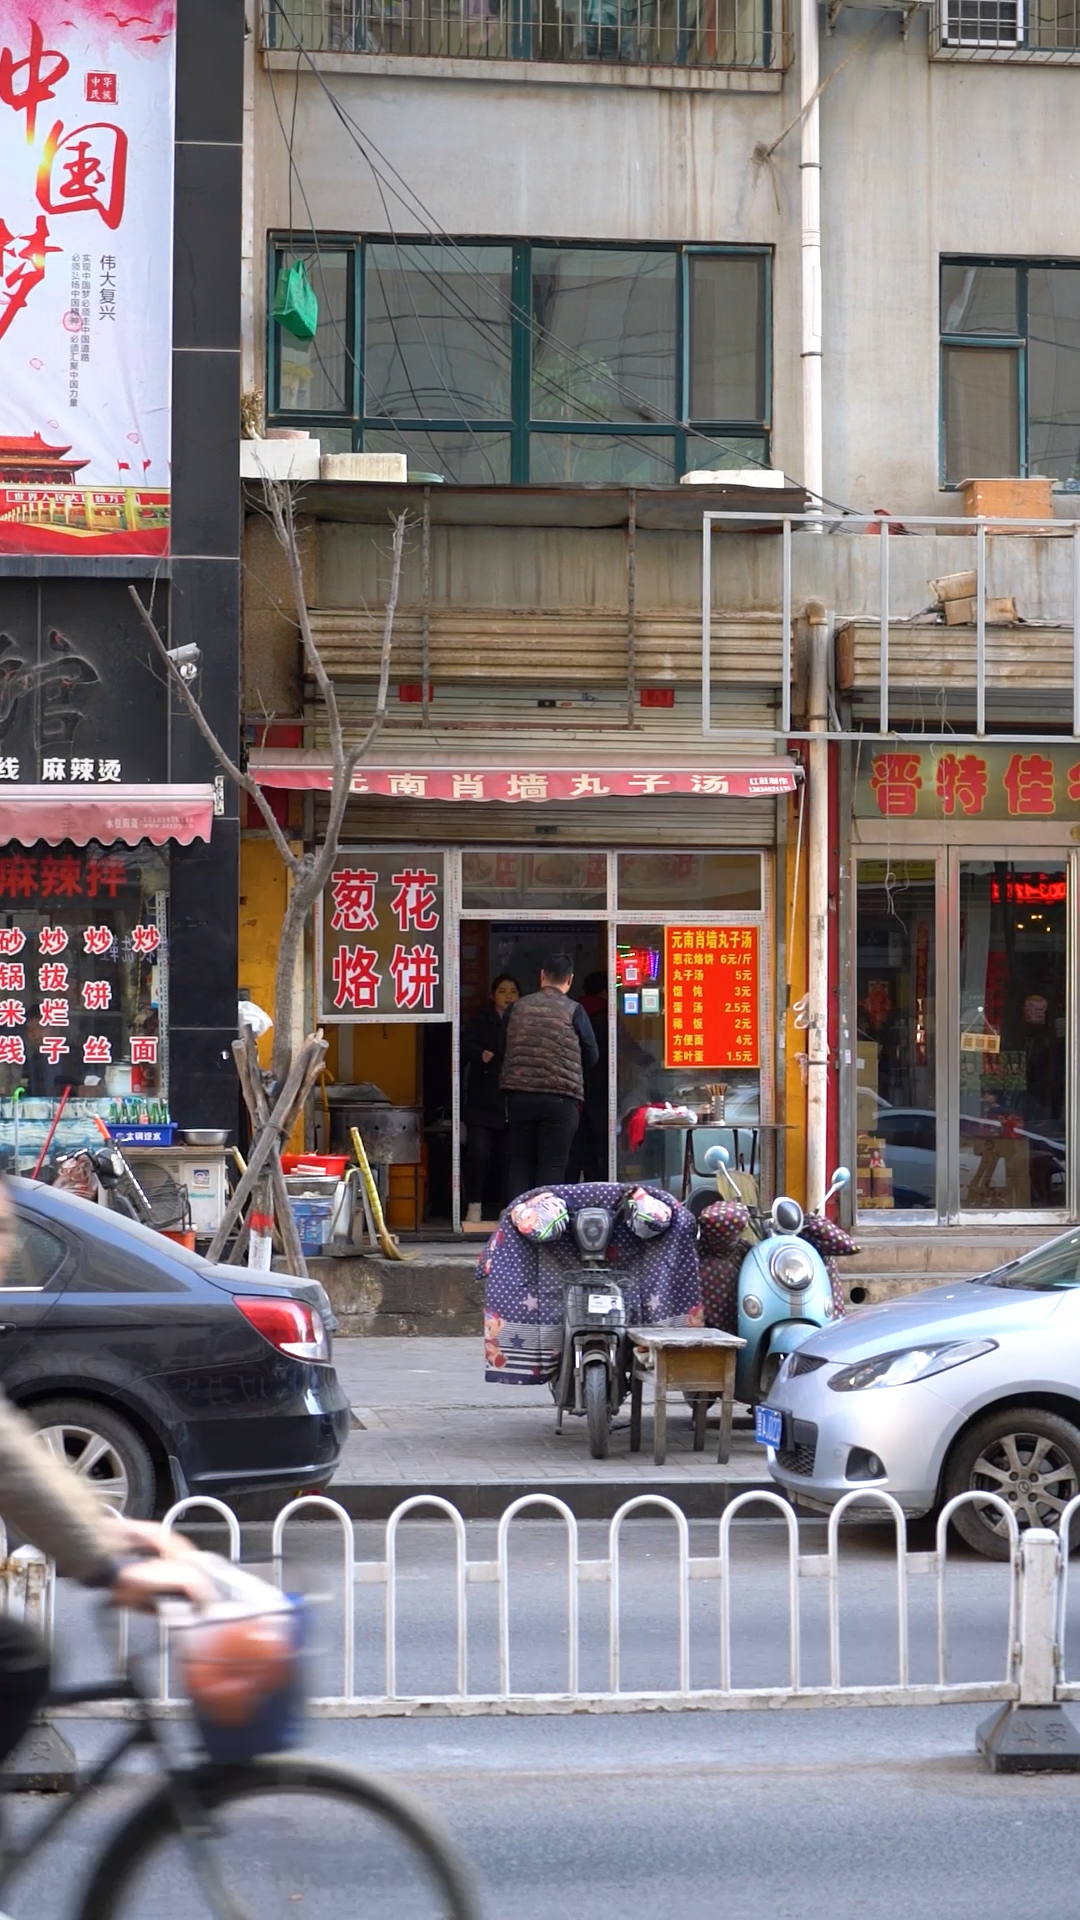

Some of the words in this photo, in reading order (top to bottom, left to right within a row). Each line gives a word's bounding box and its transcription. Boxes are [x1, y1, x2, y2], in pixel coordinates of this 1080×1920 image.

[99, 254, 116, 321] 伟大复兴
[80, 253, 91, 362] 实现中国梦必须走中国道路
[42, 757, 122, 782] 麻辣烫
[869, 753, 1080, 815] 晋特佳
[0, 854, 126, 897] 麻辣拌
[331, 868, 440, 931] 葱花
[671, 930, 753, 949] 元南肖墙丸子汤
[672, 953, 715, 965] 葱花烙饼
[720, 953, 752, 965] 6元/斤
[672, 969, 705, 981] 丸子汤
[735, 970, 753, 981] 5元
[131, 924, 161, 1063] 炒面
[332, 944, 439, 1009] 烙饼
[734, 986, 752, 997] 3元
[39, 926, 69, 1064] 炒拔烂子
[82, 925, 112, 1063] 炒饼丝
[724, 1002, 752, 1013] 2.5元
[672, 1034, 705, 1046] 方便面
[735, 1034, 753, 1046] 4元
[734, 1018, 752, 1029] 2元
[672, 1050, 705, 1062] 茶叶蛋
[726, 1050, 753, 1062] 1.5元
